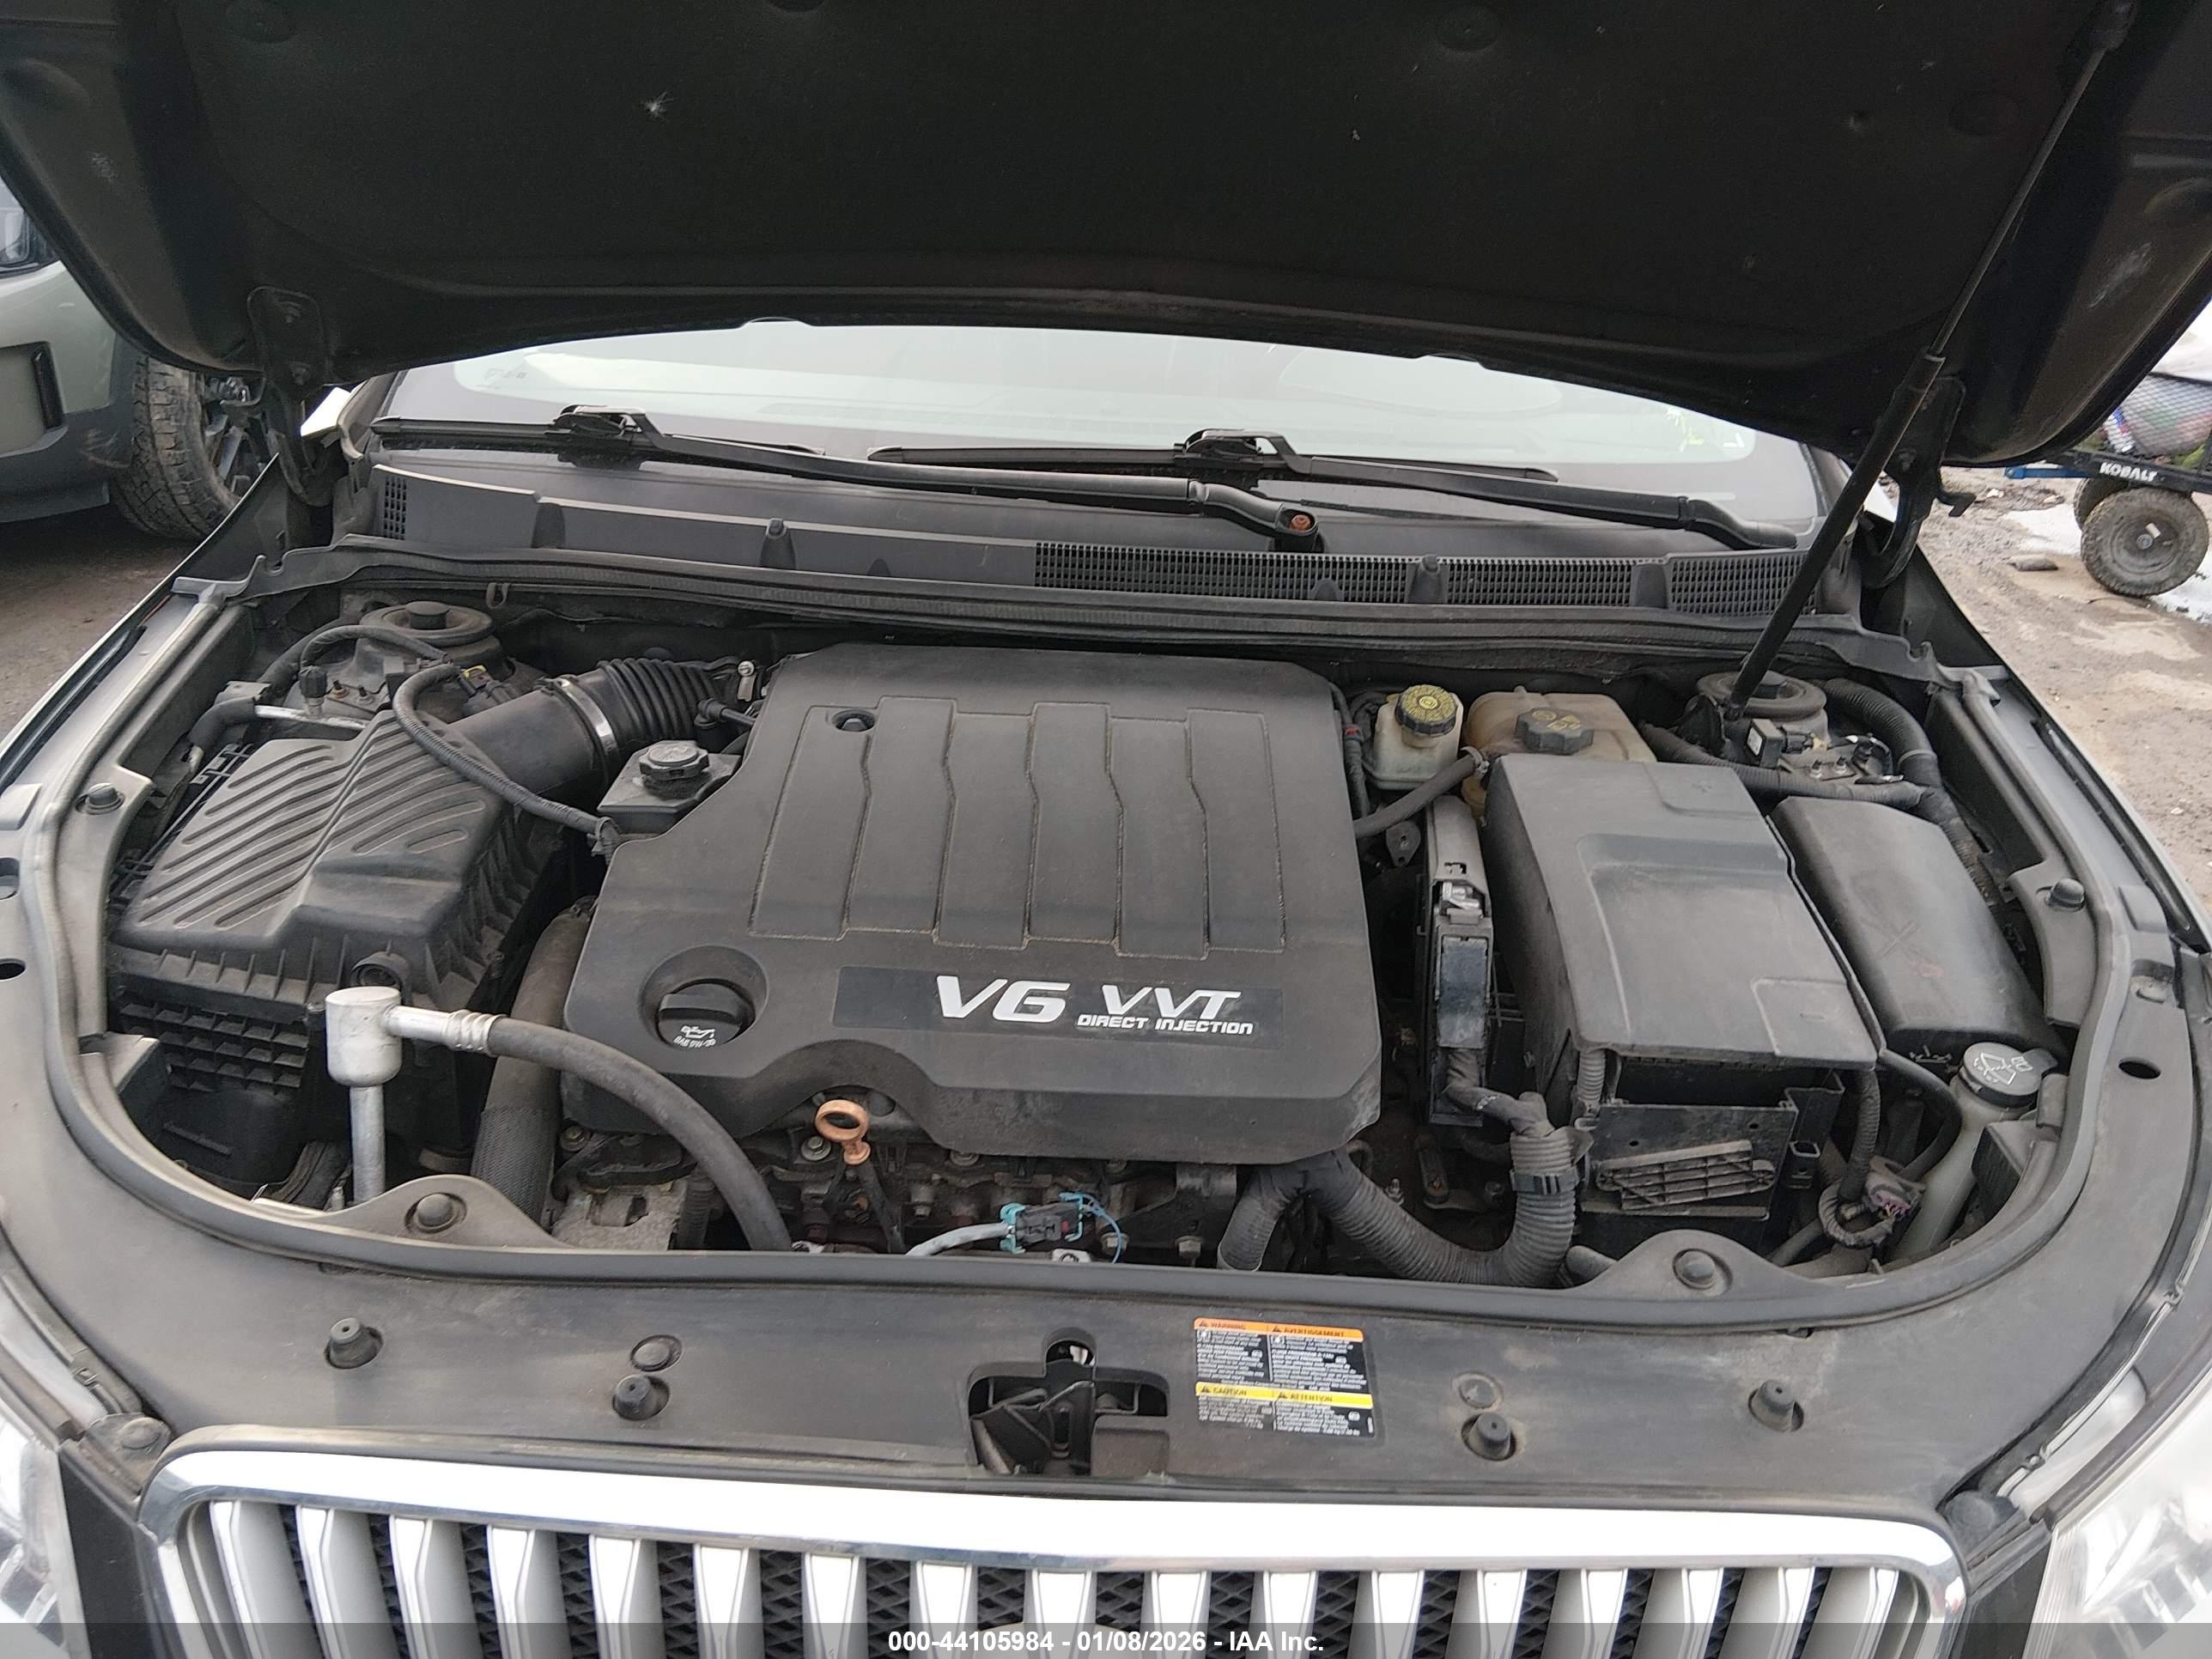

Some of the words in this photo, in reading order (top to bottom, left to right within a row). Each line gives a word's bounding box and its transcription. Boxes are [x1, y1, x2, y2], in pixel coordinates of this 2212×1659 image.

[2100, 462, 2158, 482] KOBALT
[937, 975, 1071, 1024] V6
[1102, 984, 1242, 1020] VVT
[1077, 1013, 1150, 1030] DIRECT
[1155, 1018, 1254, 1036] INJECTION
